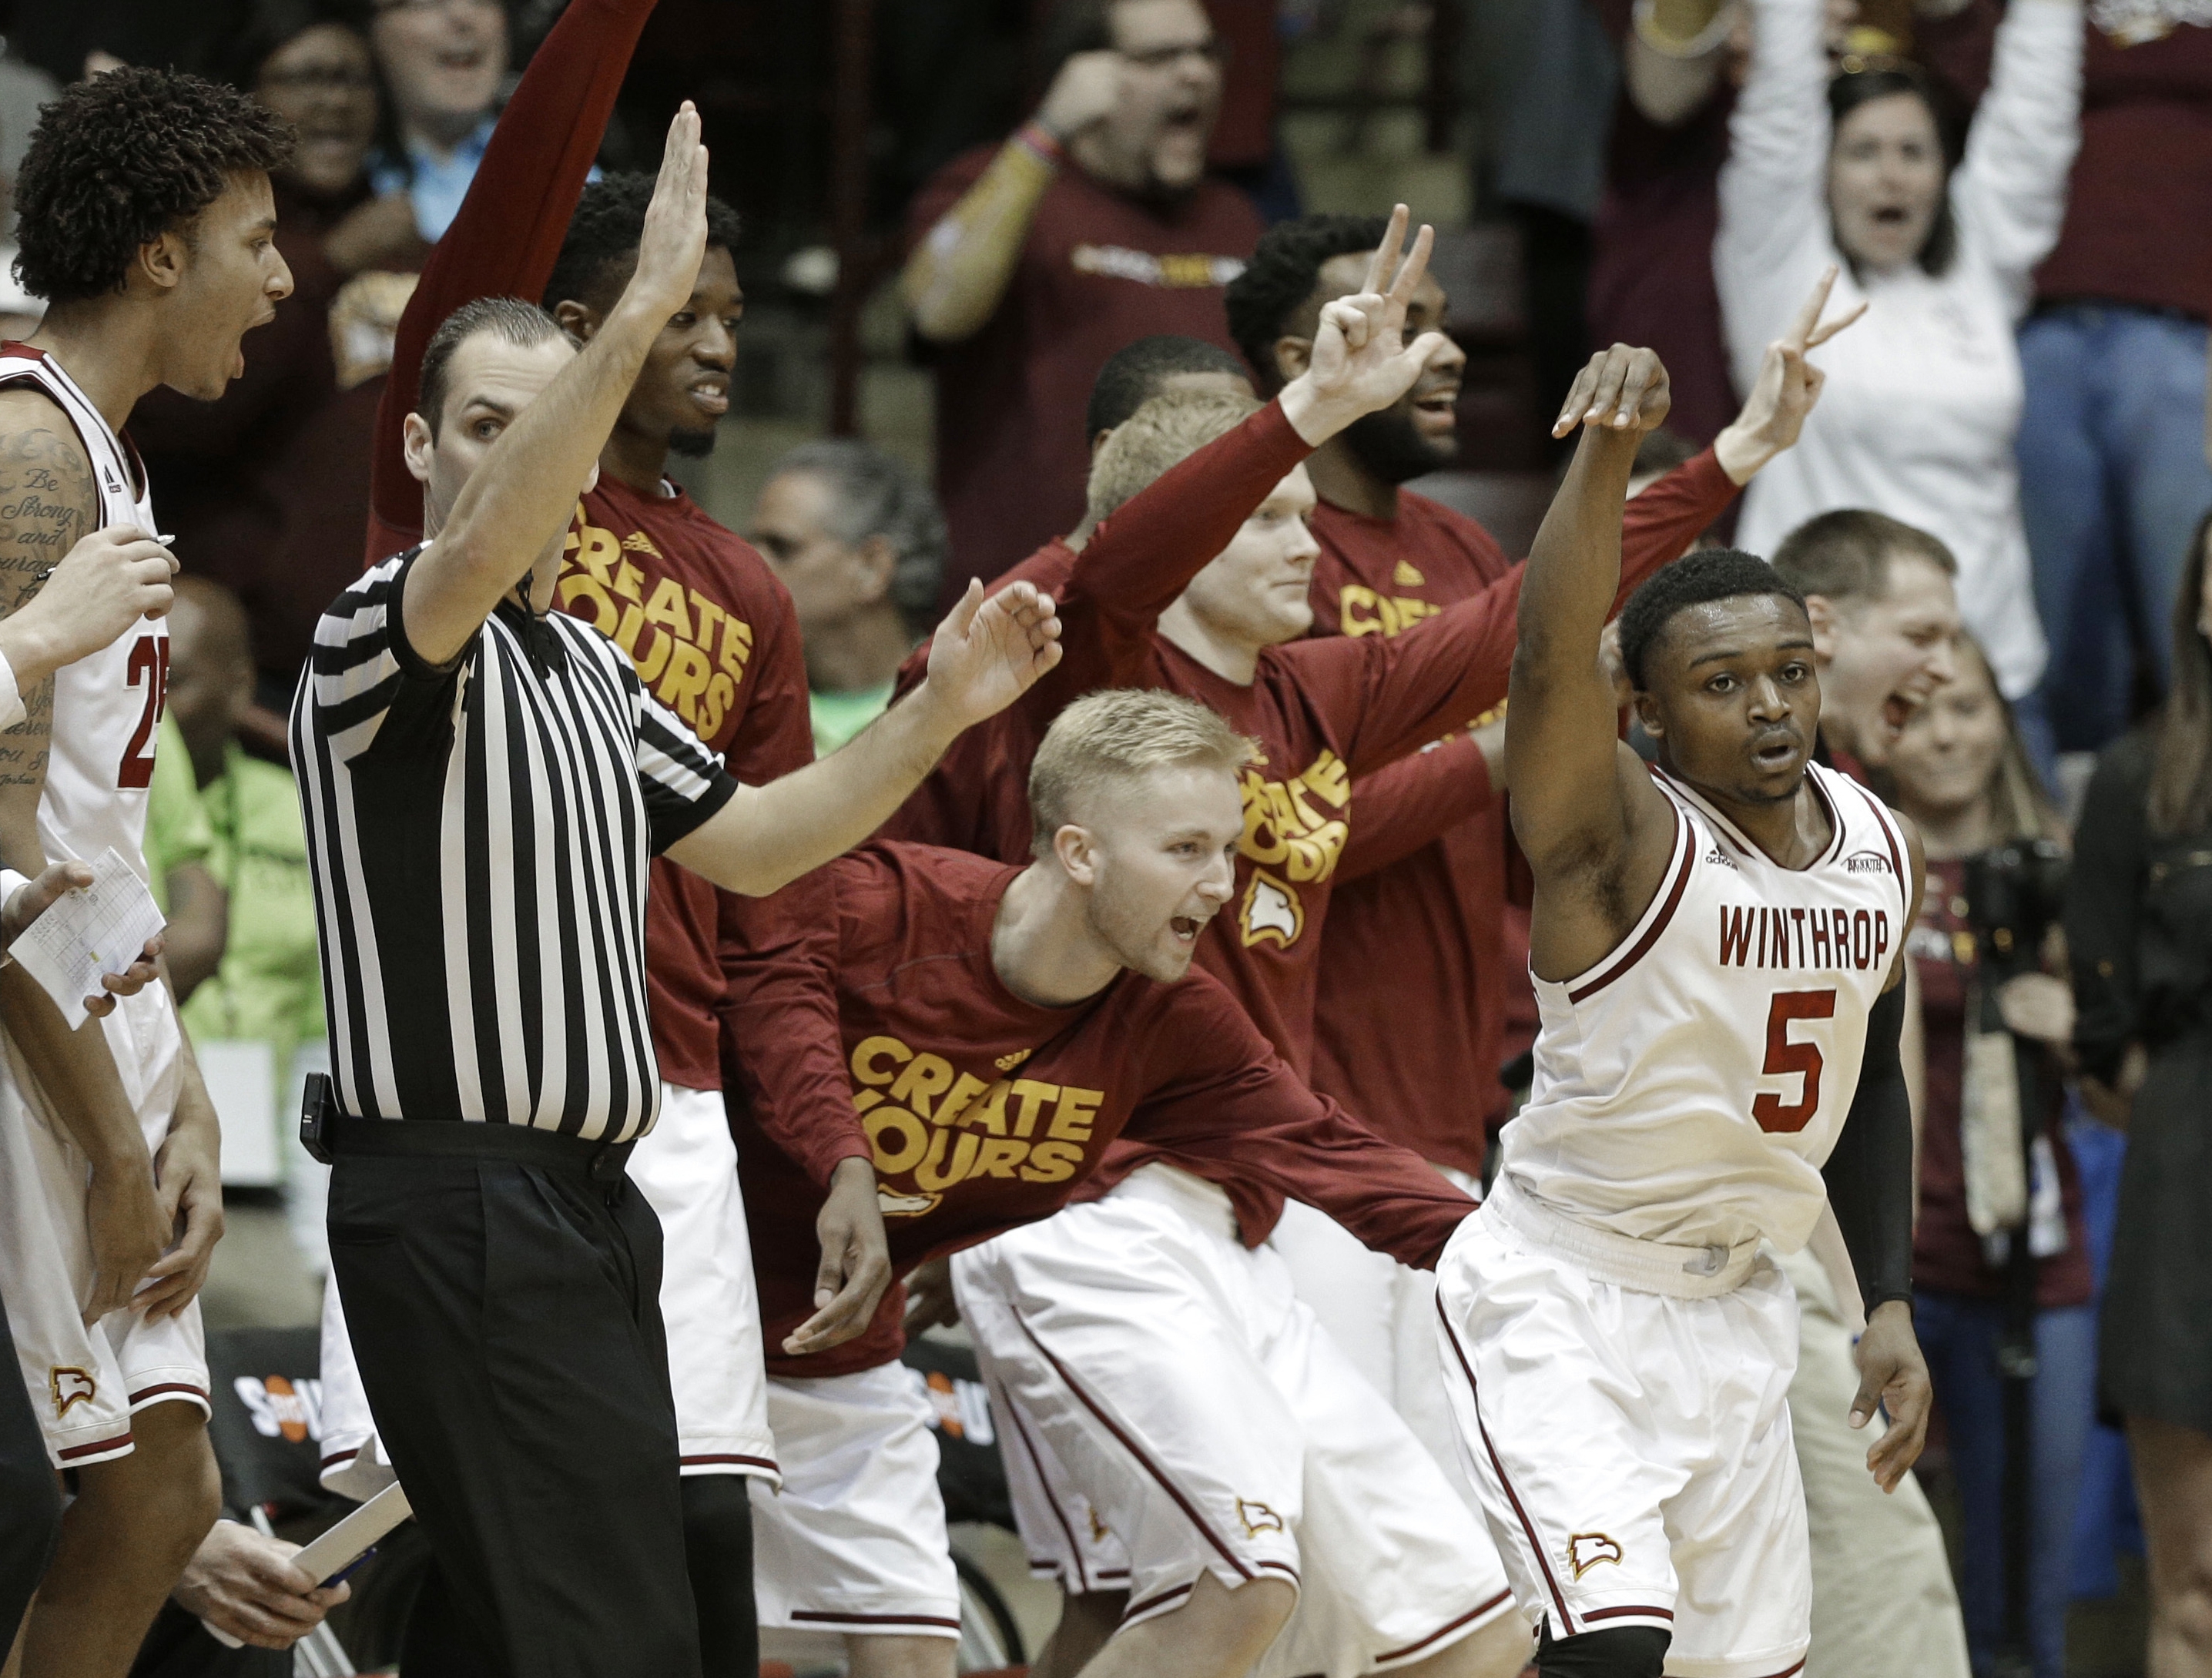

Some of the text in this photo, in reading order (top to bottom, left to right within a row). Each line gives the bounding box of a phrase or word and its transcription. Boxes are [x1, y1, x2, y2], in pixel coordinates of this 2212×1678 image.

[23, 468, 59, 491] Be
[1718, 904, 1889, 970] WINTHROP
[1751, 988, 1837, 1133] 5
